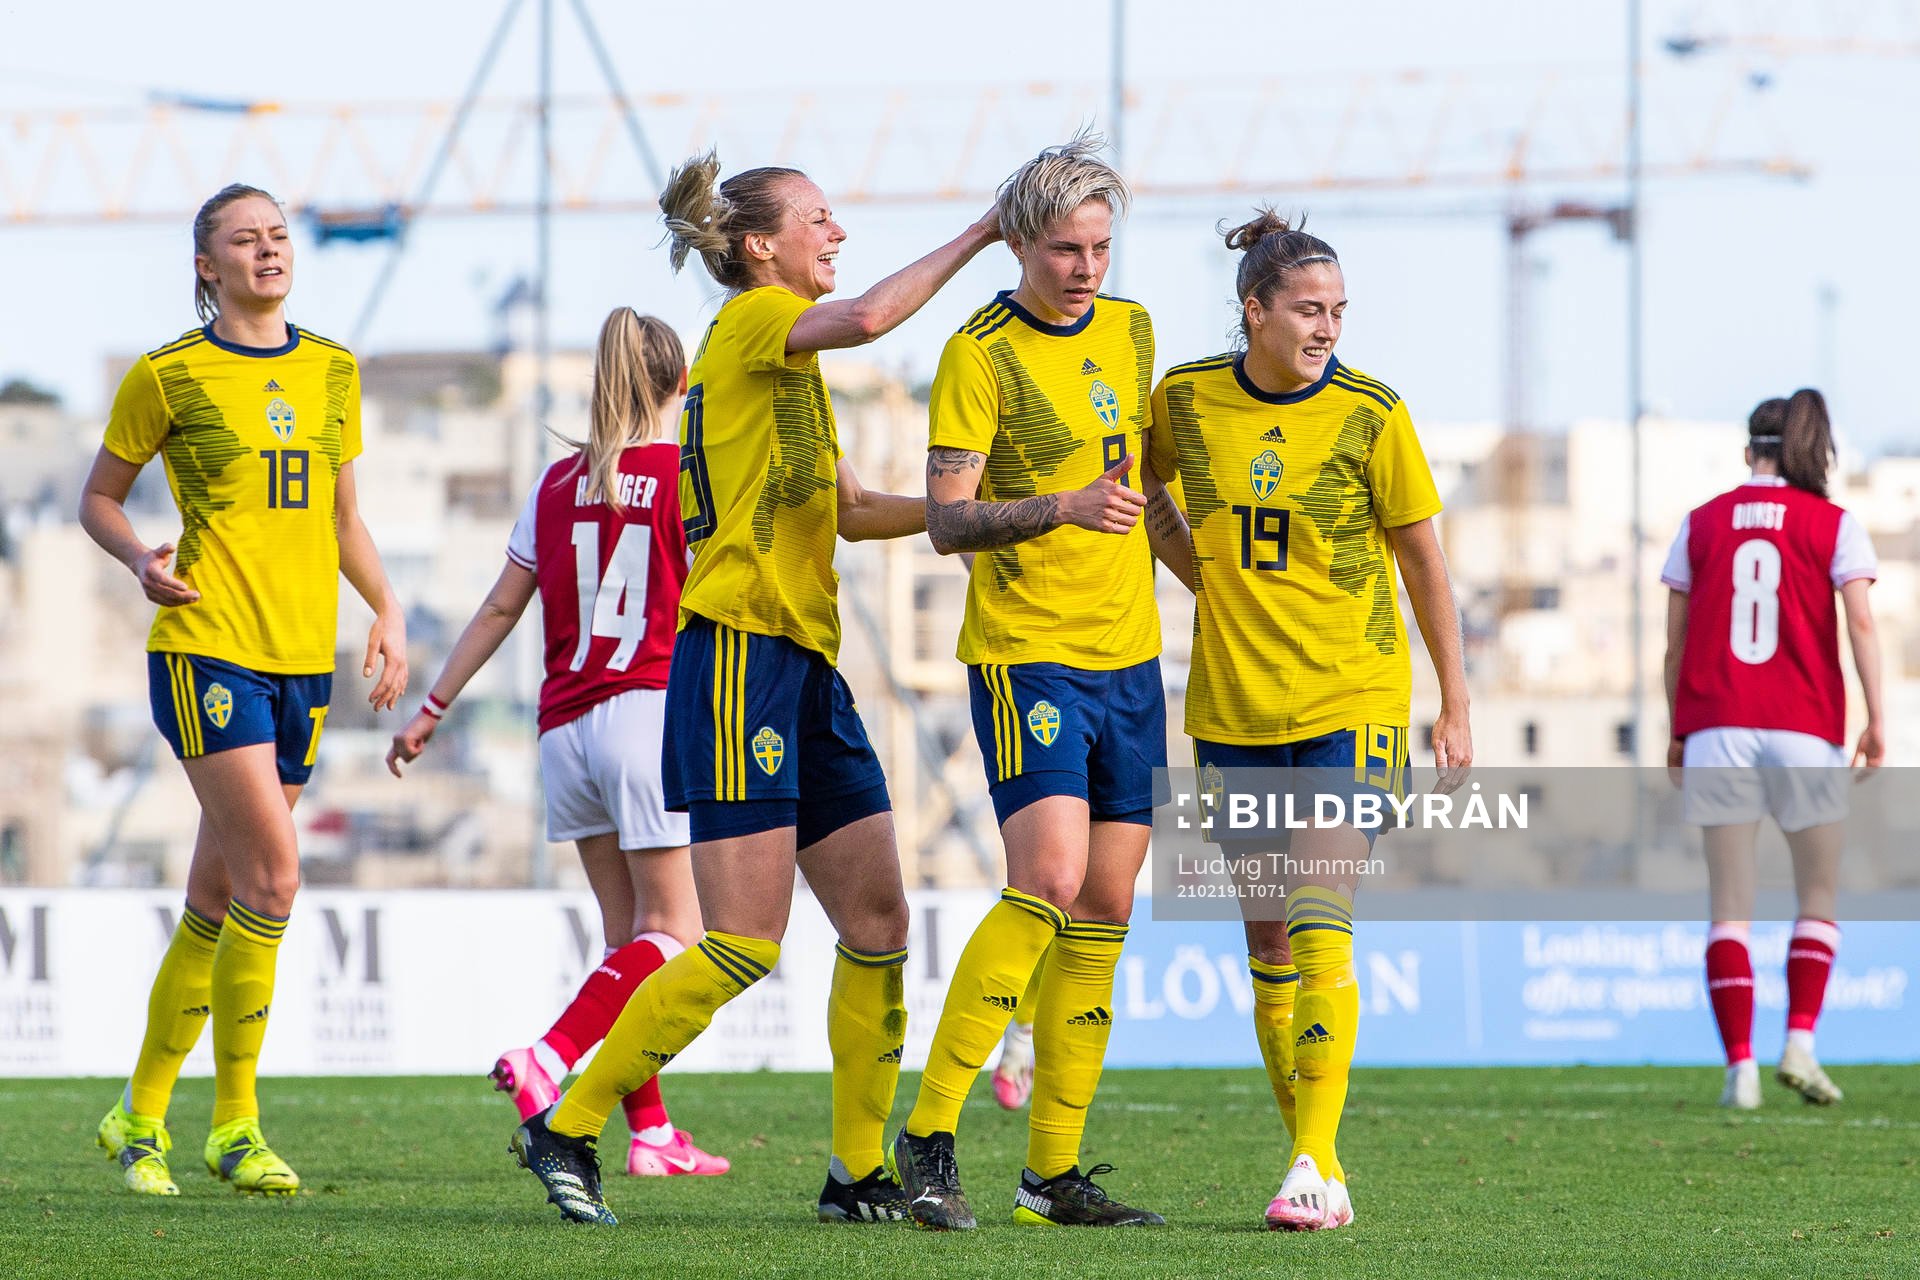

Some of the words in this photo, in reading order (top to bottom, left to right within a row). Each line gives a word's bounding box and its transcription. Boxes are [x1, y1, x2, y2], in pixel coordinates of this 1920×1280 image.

[260, 450, 309, 509] 18
[575, 472, 658, 509] HGER
[1231, 505, 1290, 571] 19
[569, 521, 651, 672] 14
[1730, 538, 1781, 665] 8
[1346, 724, 1394, 791] 19
[1296, 1035, 1335, 1047] adidas
